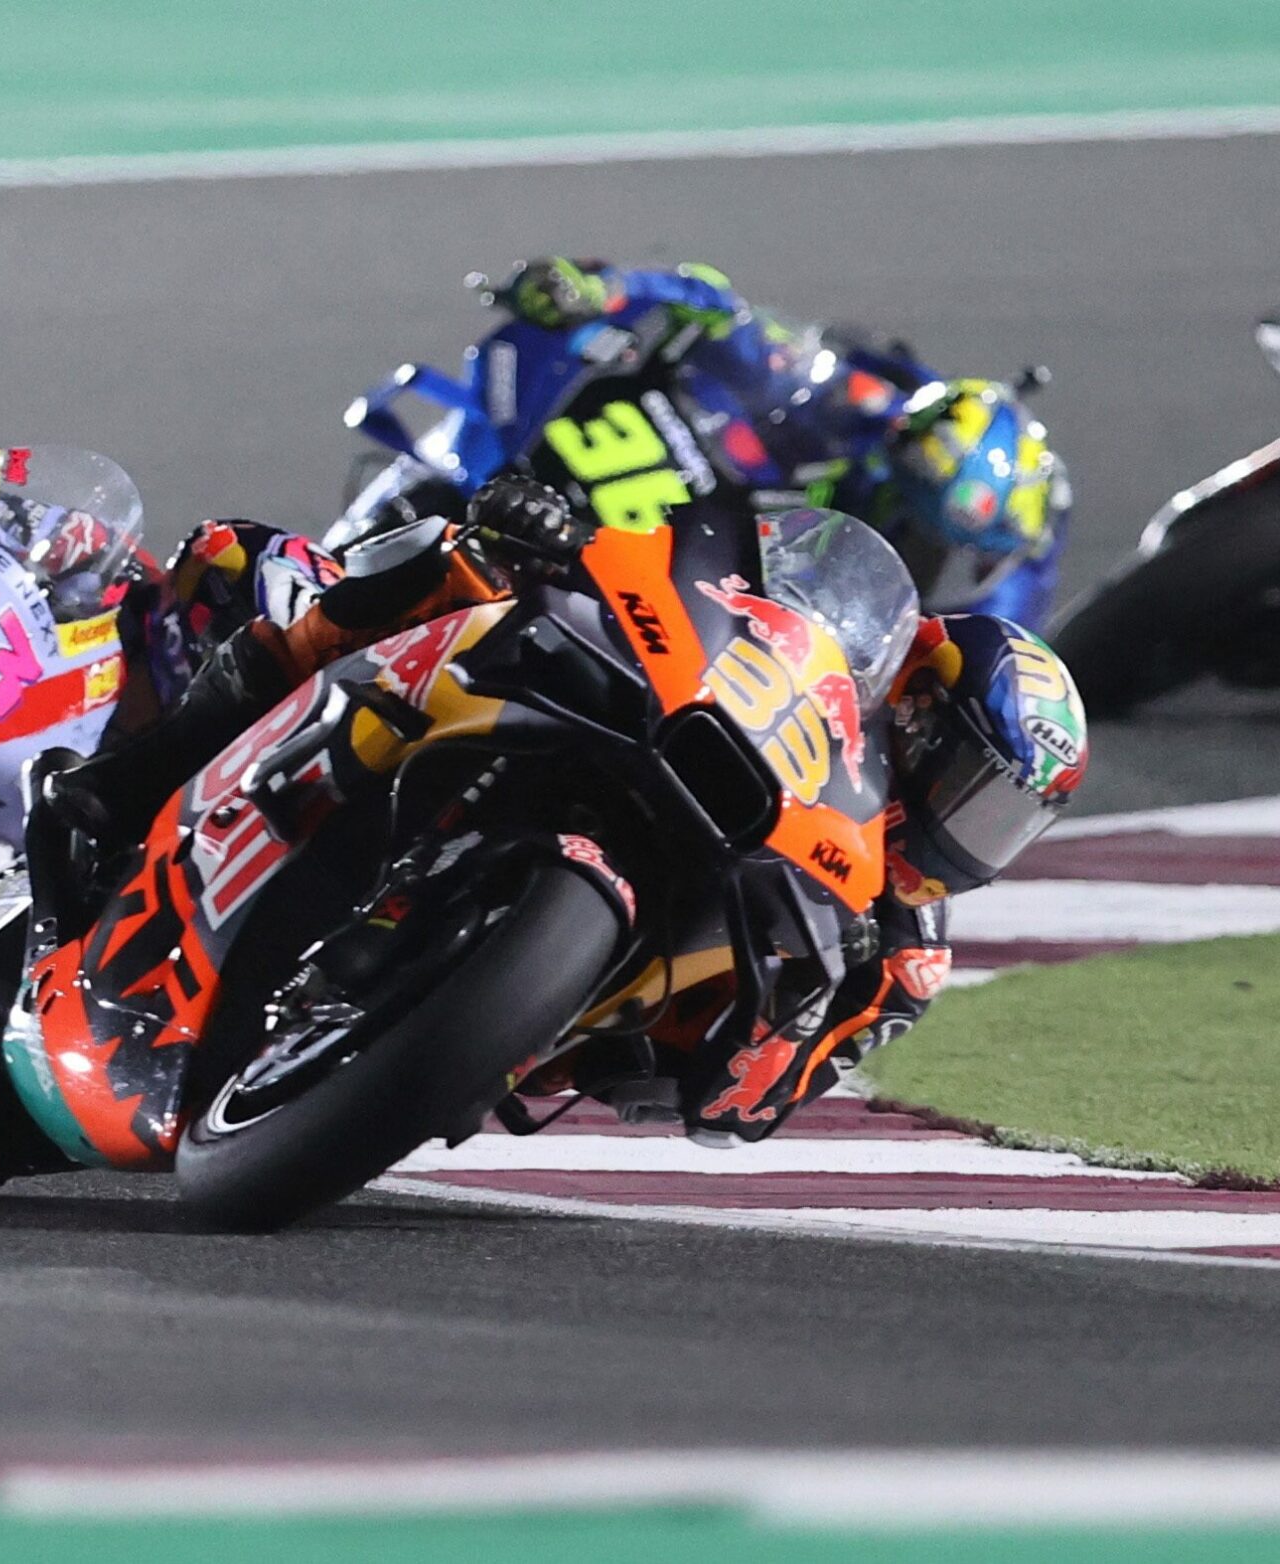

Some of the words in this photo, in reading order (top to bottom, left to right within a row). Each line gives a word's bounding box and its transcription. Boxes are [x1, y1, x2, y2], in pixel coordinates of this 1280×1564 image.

[16, 579, 60, 658] NEXT
[616, 591, 670, 655] KTM
[701, 636, 830, 806] 33
[810, 840, 852, 884] KTM
